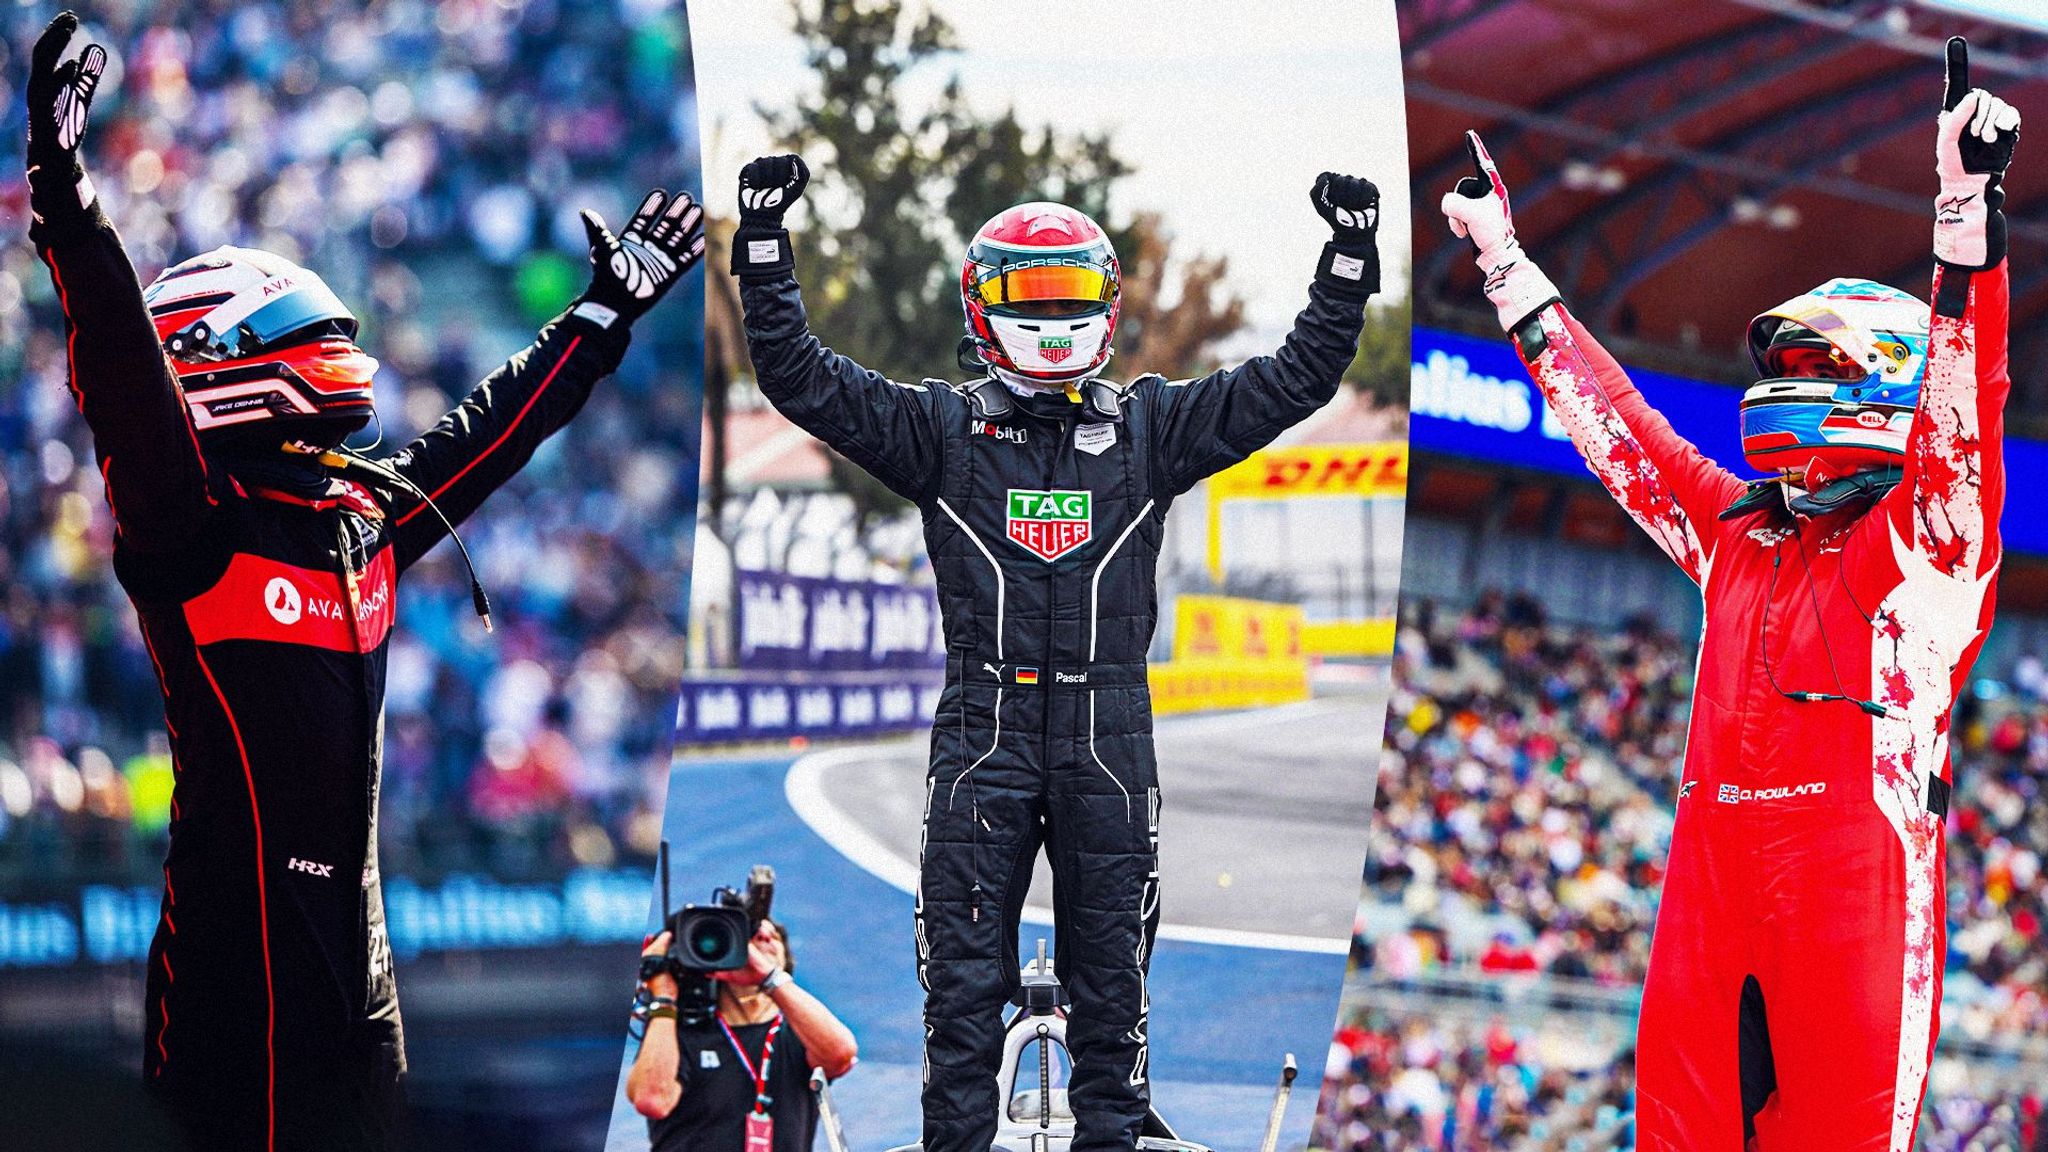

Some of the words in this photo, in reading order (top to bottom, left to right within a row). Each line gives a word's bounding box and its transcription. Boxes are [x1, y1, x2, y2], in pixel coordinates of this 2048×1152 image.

[1043, 339, 1070, 347] TAG
[1041, 350, 1070, 363] HEUER
[212, 404, 233, 413] JAKE
[234, 398, 264, 408] DENNIS
[1861, 415, 1882, 423] BELL
[1015, 495, 1083, 516] TAG
[1012, 522, 1086, 555] HEUER
[1055, 671, 1088, 683] Pascal
[1740, 789, 1752, 800] O.
[1754, 781, 1826, 800] ROWLAND
[287, 857, 334, 878] HRX
